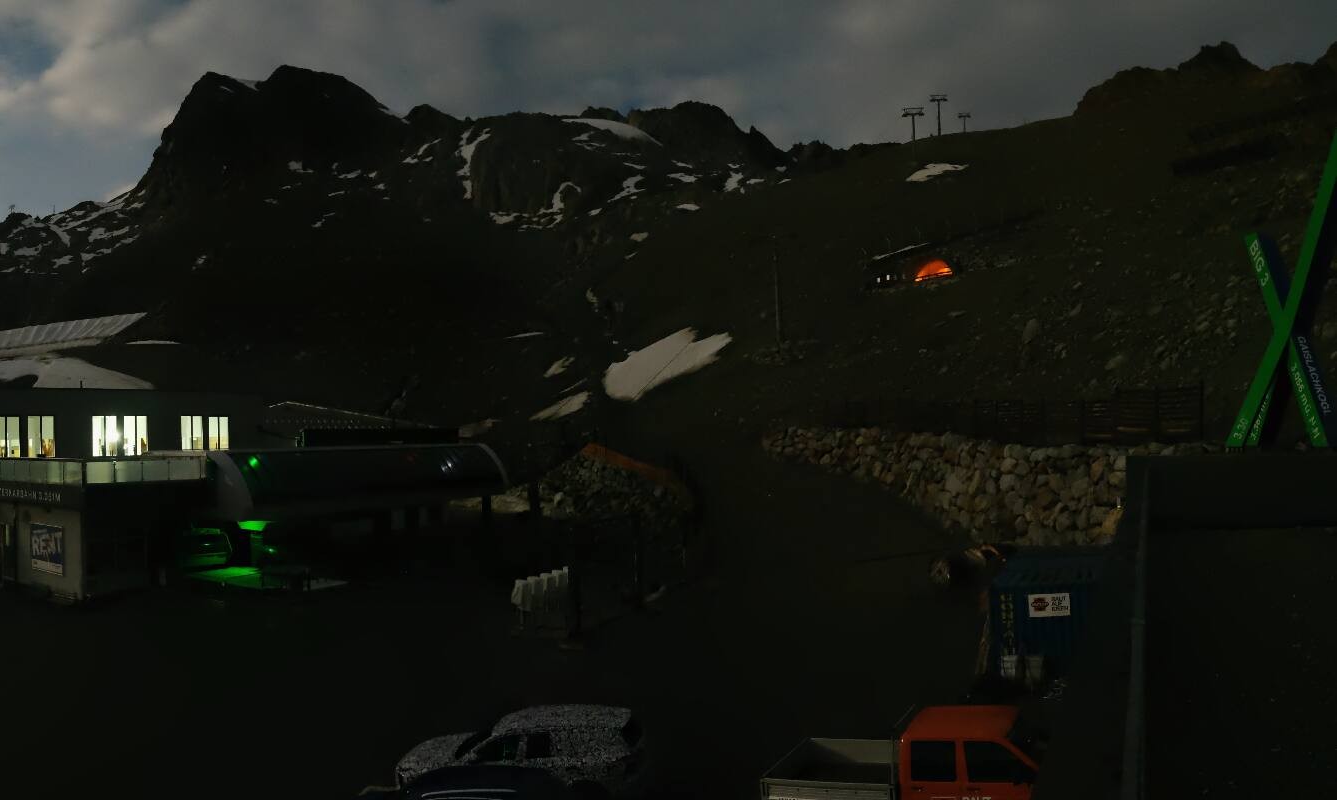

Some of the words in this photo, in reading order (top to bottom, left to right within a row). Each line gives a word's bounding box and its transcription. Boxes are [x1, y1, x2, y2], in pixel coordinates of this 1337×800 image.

[1249, 239, 1264, 272] BIG
[1260, 272, 1269, 287] 3
[1297, 336, 1332, 416] GAISLACHKOGL
[31, 532, 63, 557] RENT
